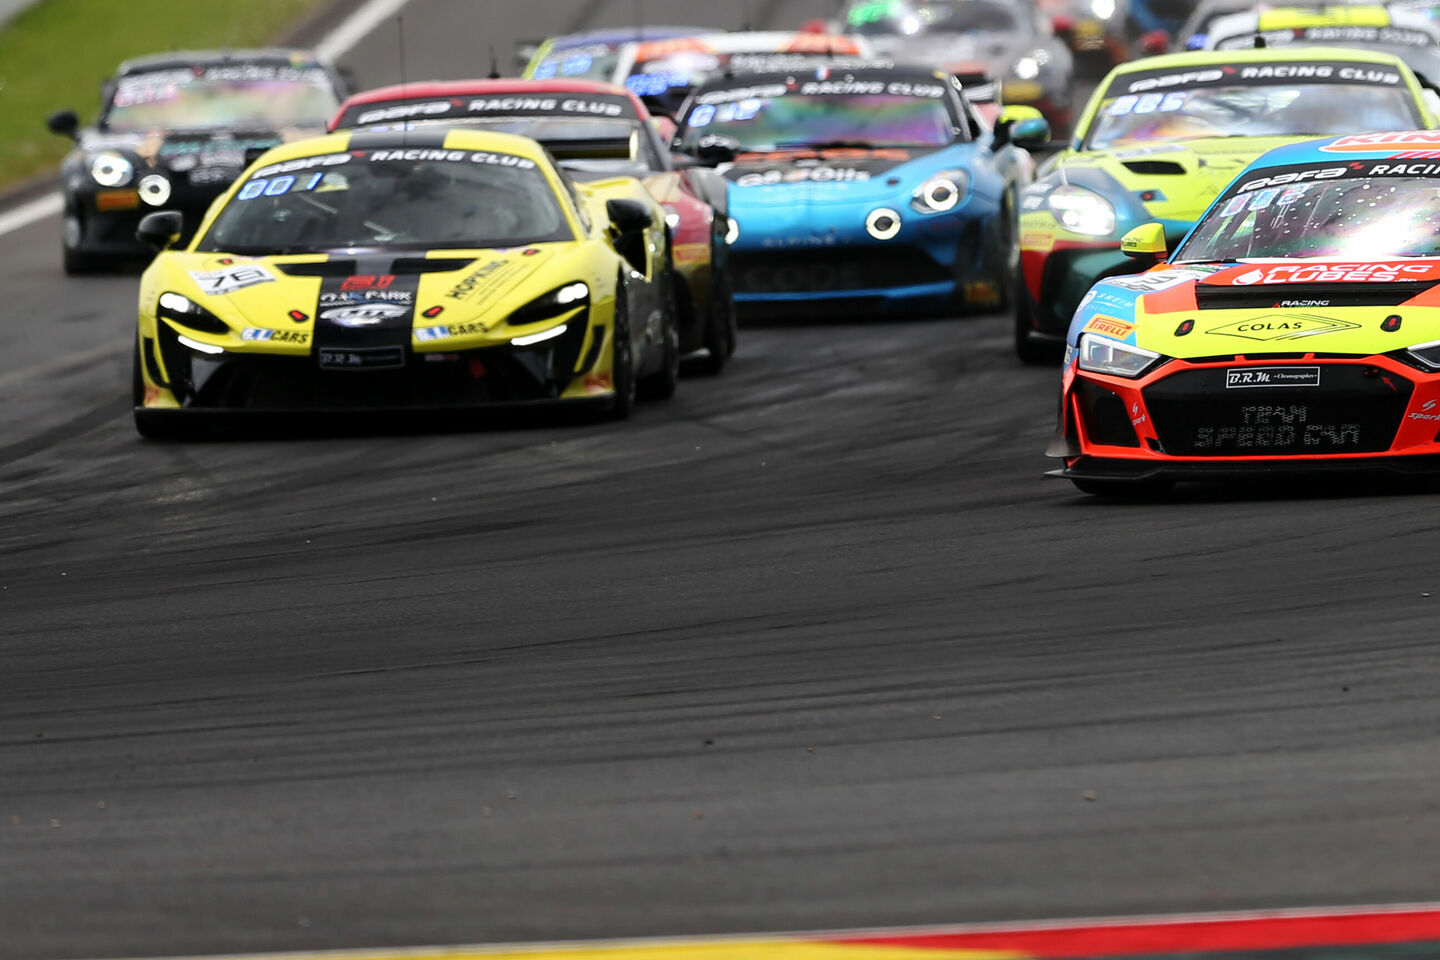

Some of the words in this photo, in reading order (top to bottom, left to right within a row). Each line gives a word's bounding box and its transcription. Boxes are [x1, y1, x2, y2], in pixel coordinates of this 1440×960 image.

[1241, 65, 1332, 78] RACING
[1338, 67, 1400, 85] CLUB
[467, 98, 557, 111] RACING
[561, 100, 622, 116] CLUB
[370, 149, 466, 161] RACING
[470, 152, 537, 169] CLUB
[1275, 264, 1433, 273] RACING
[1088, 317, 1133, 336] PIRELLI
[1237, 321, 1303, 332] COLAS
[1228, 372, 1271, 384] B.R.M
[1242, 406, 1308, 423] TEAM
[1194, 425, 1296, 447] SPEED
[1304, 424, 1360, 445] CAR
